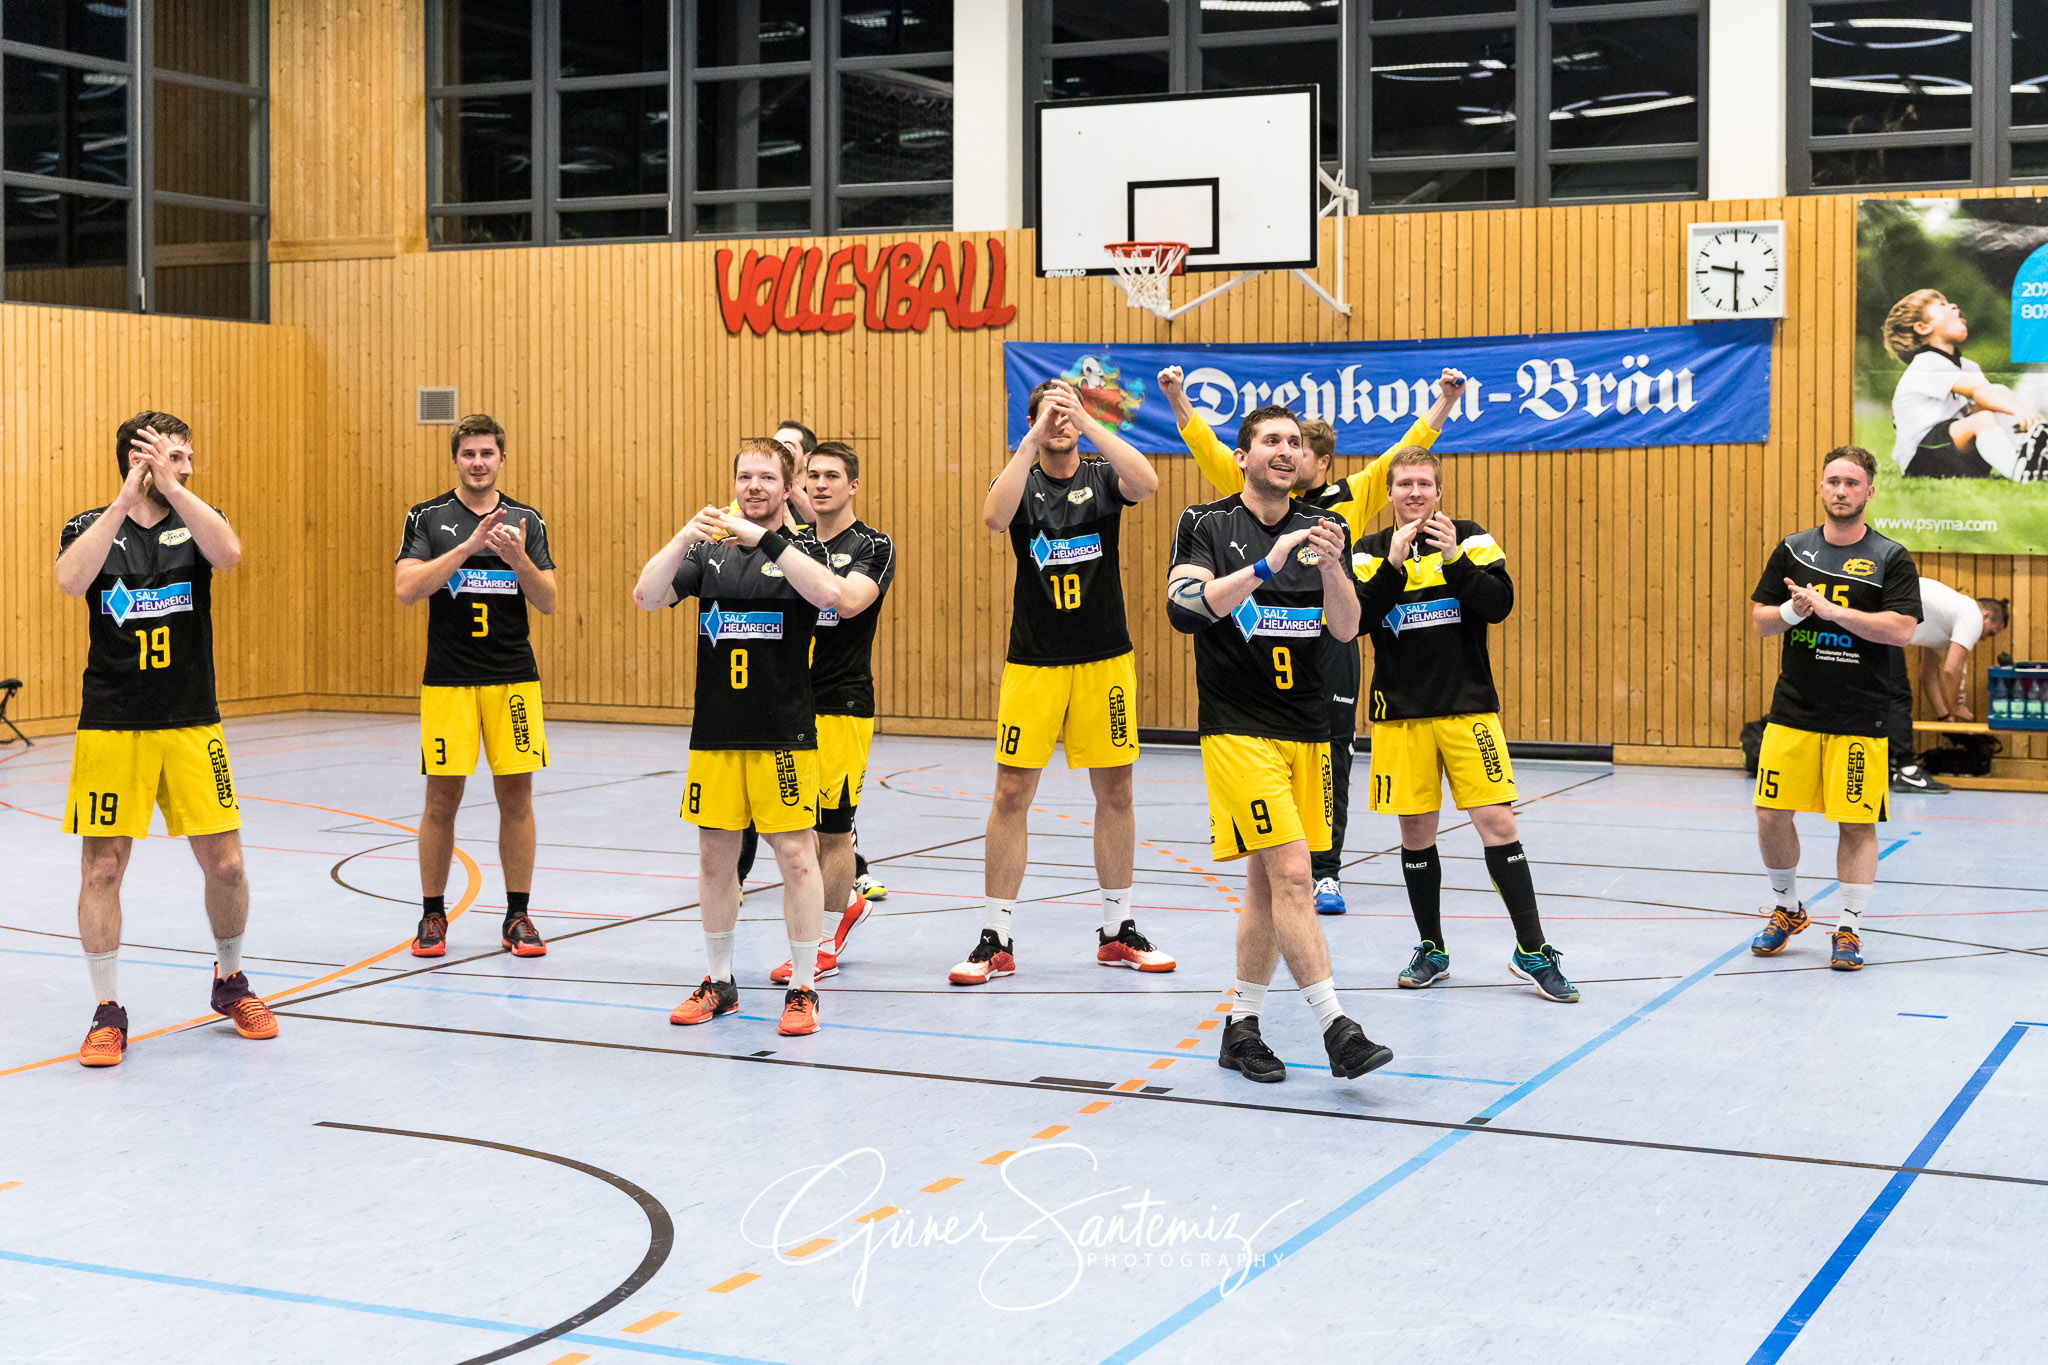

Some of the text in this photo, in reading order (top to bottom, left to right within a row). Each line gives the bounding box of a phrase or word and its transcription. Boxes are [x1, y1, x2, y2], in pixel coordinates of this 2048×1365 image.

[715, 238, 1017, 336] VOLLEYBALL
[1182, 354, 1698, 425] Dreykorn-Bräu
[1874, 517, 1998, 533] www.psyma.com
[1052, 541, 1071, 550] SALZ
[1052, 544, 1099, 559] HELMREICH
[467, 571, 488, 580] SALZ
[467, 579, 516, 589] HELMREICH
[1050, 573, 1081, 610] 18
[135, 591, 160, 602] SALZ
[135, 594, 190, 611] HELMREICH
[1406, 604, 1428, 615] SALZ
[471, 602, 489, 638] 3
[723, 613, 748, 623] SALZ
[723, 623, 781, 633] HELMREICH
[1262, 619, 1321, 631] HELMREICH
[1263, 608, 1289, 620] SALZ
[1406, 609, 1459, 623] HELMREICH
[135, 625, 171, 670] 19
[1790, 628, 1852, 649] psyma
[730, 648, 749, 690] 8
[1272, 646, 1294, 690] 9
[509, 704, 522, 747] ROBERT
[516, 701, 530, 745] MEIER
[1109, 696, 1119, 740] ROBERT
[1116, 693, 1128, 739] MEIER
[434, 737, 447, 766] 3
[1000, 723, 1021, 755] 18
[1475, 732, 1495, 776] ROBERT
[1481, 728, 1503, 774] MEIER
[208, 750, 227, 801] ROBERT
[216, 747, 234, 799] MEIER
[1375, 774, 1391, 804] 11
[1758, 767, 1780, 799] 15
[1847, 752, 1856, 795] ROBERT
[1853, 750, 1865, 796] MEIER
[89, 791, 118, 826] 19
[689, 782, 702, 815] 8
[1250, 798, 1273, 835] 9
[1405, 861, 1428, 869] SELECT
